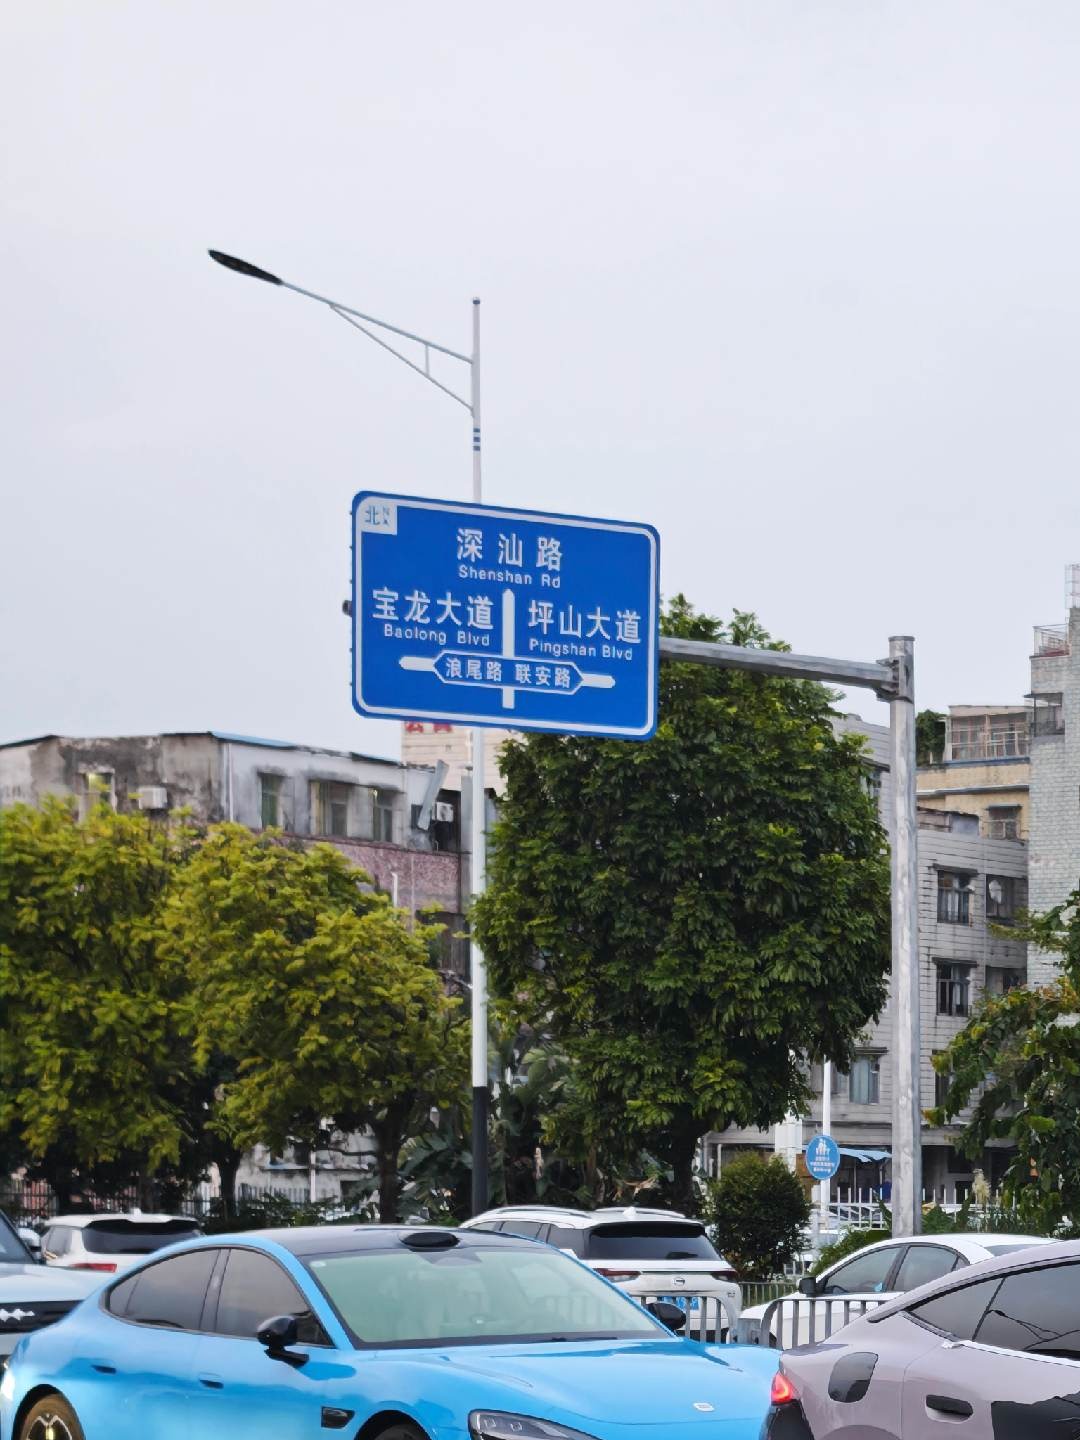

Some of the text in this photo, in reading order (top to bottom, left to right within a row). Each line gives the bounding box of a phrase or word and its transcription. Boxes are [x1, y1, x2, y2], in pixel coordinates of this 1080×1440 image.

[365, 505, 379, 525] 北
[457, 528, 562, 572] 深汕路
[459, 565, 560, 588] Shenshan Rd
[373, 587, 493, 630] 宝龙大道
[528, 600, 640, 644] 坪山大道
[384, 624, 489, 646] Baolong Blvd
[529, 638, 632, 660] Pingshan Blvd
[446, 657, 502, 681] 浪尾路
[515, 663, 571, 688] 联安路
